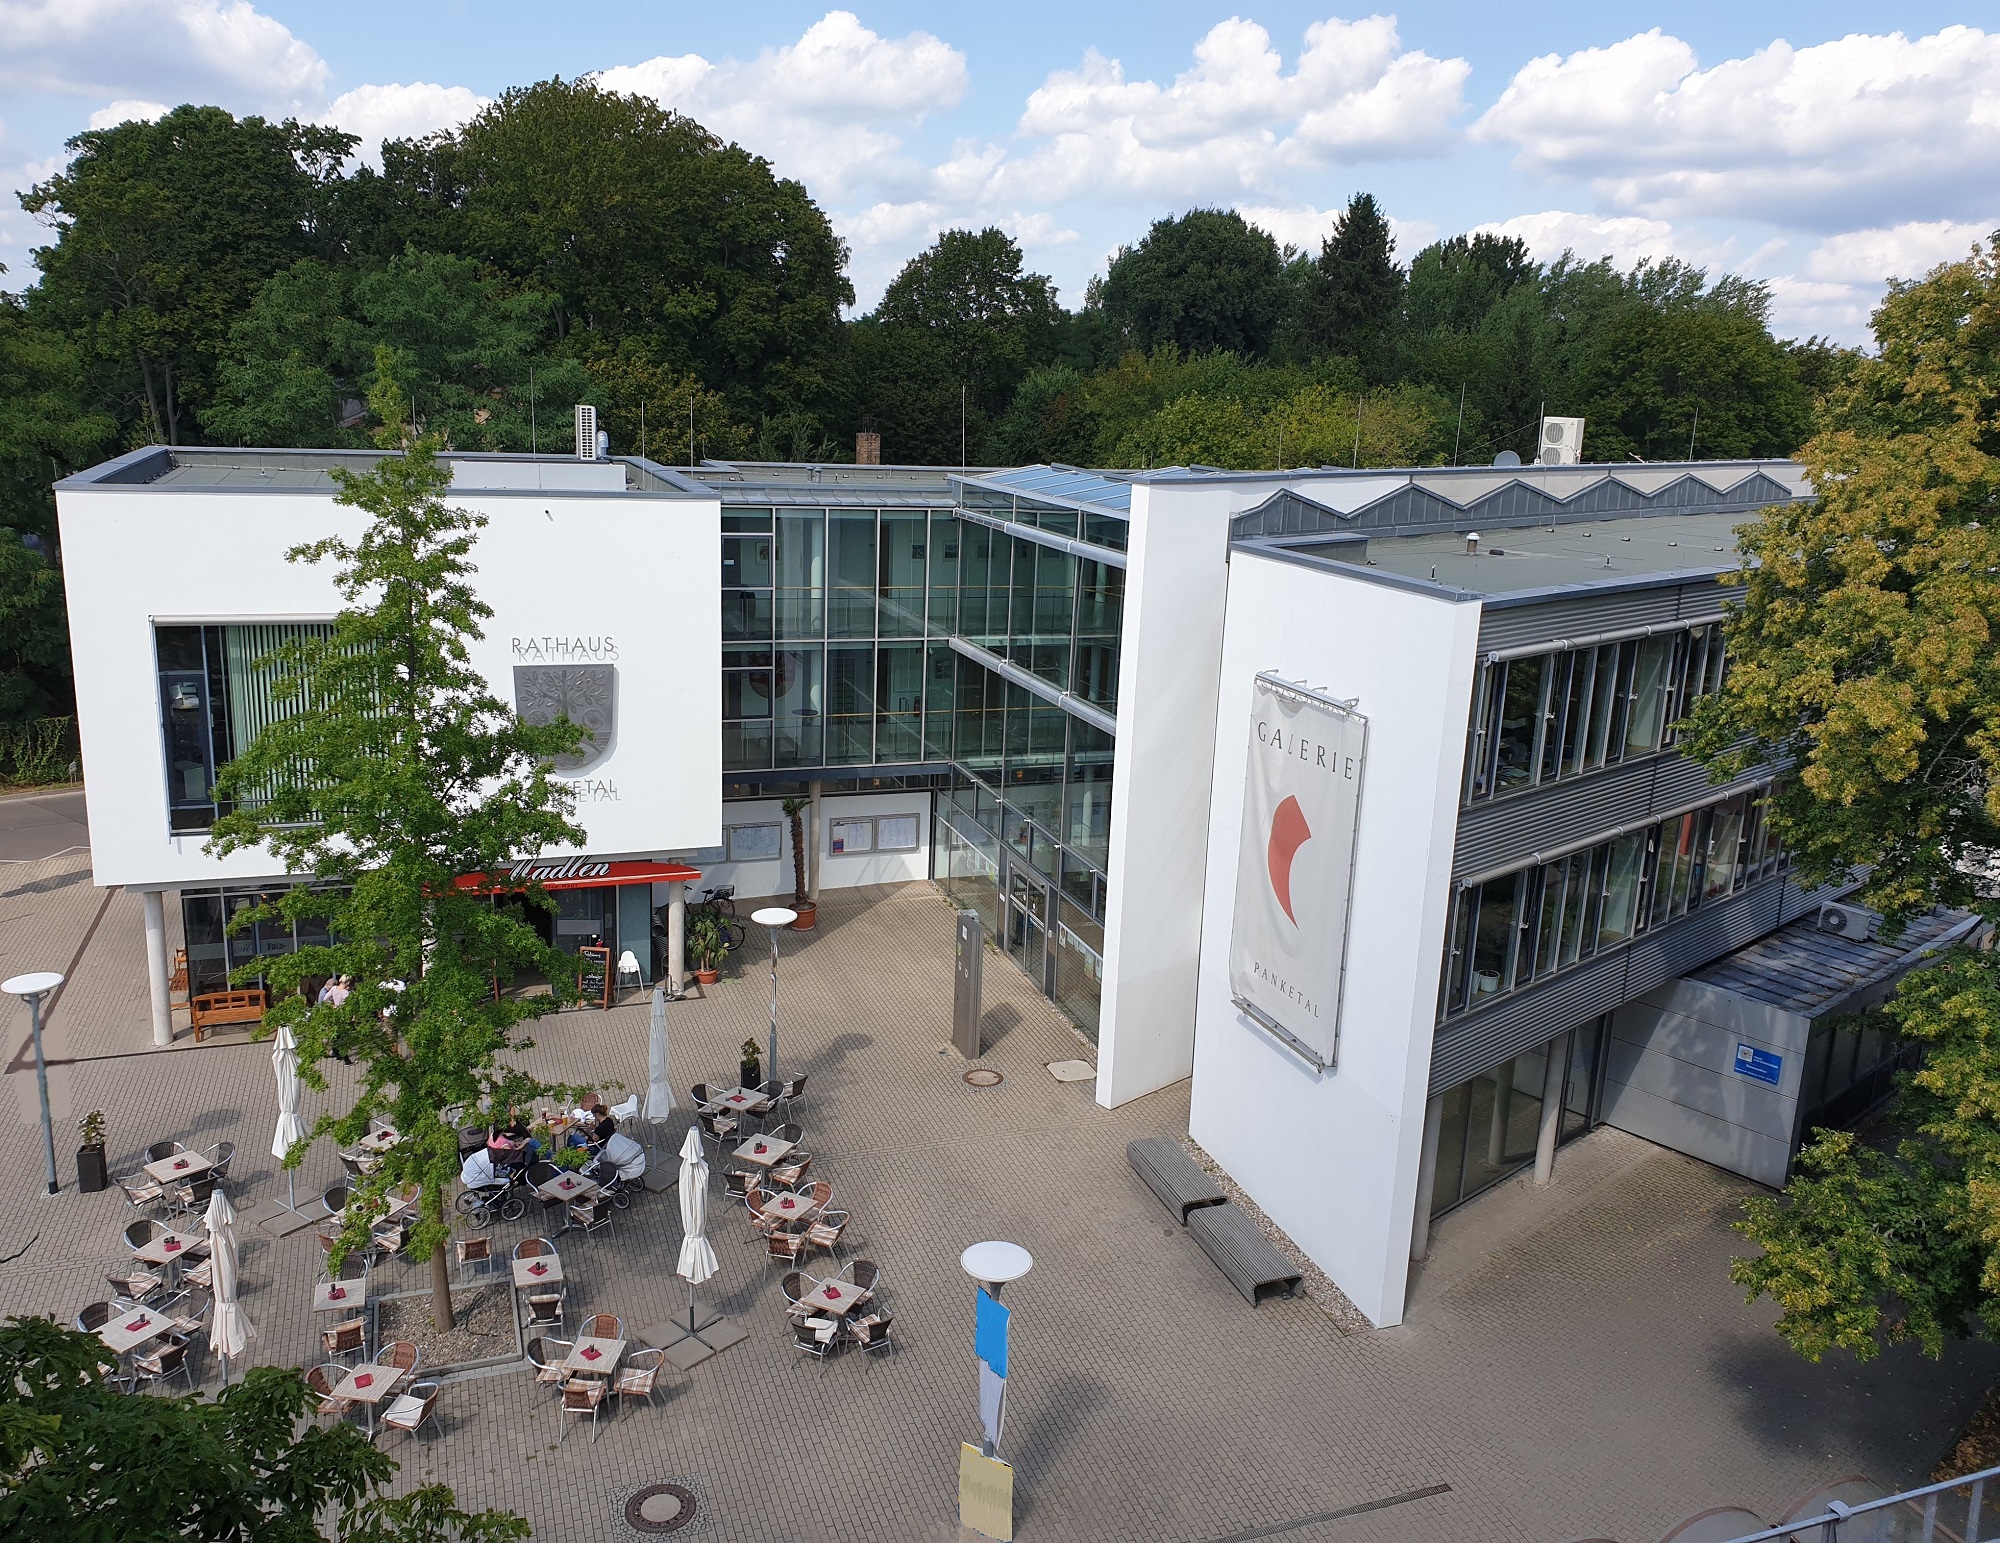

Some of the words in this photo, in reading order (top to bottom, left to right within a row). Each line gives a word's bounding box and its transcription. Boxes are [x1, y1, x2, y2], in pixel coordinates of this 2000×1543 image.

[511, 636, 615, 654] RATHAUS
[1257, 720, 1354, 781] GALERIE
[508, 855, 611, 881] Madlen
[1253, 961, 1319, 1018] PANKETAL
